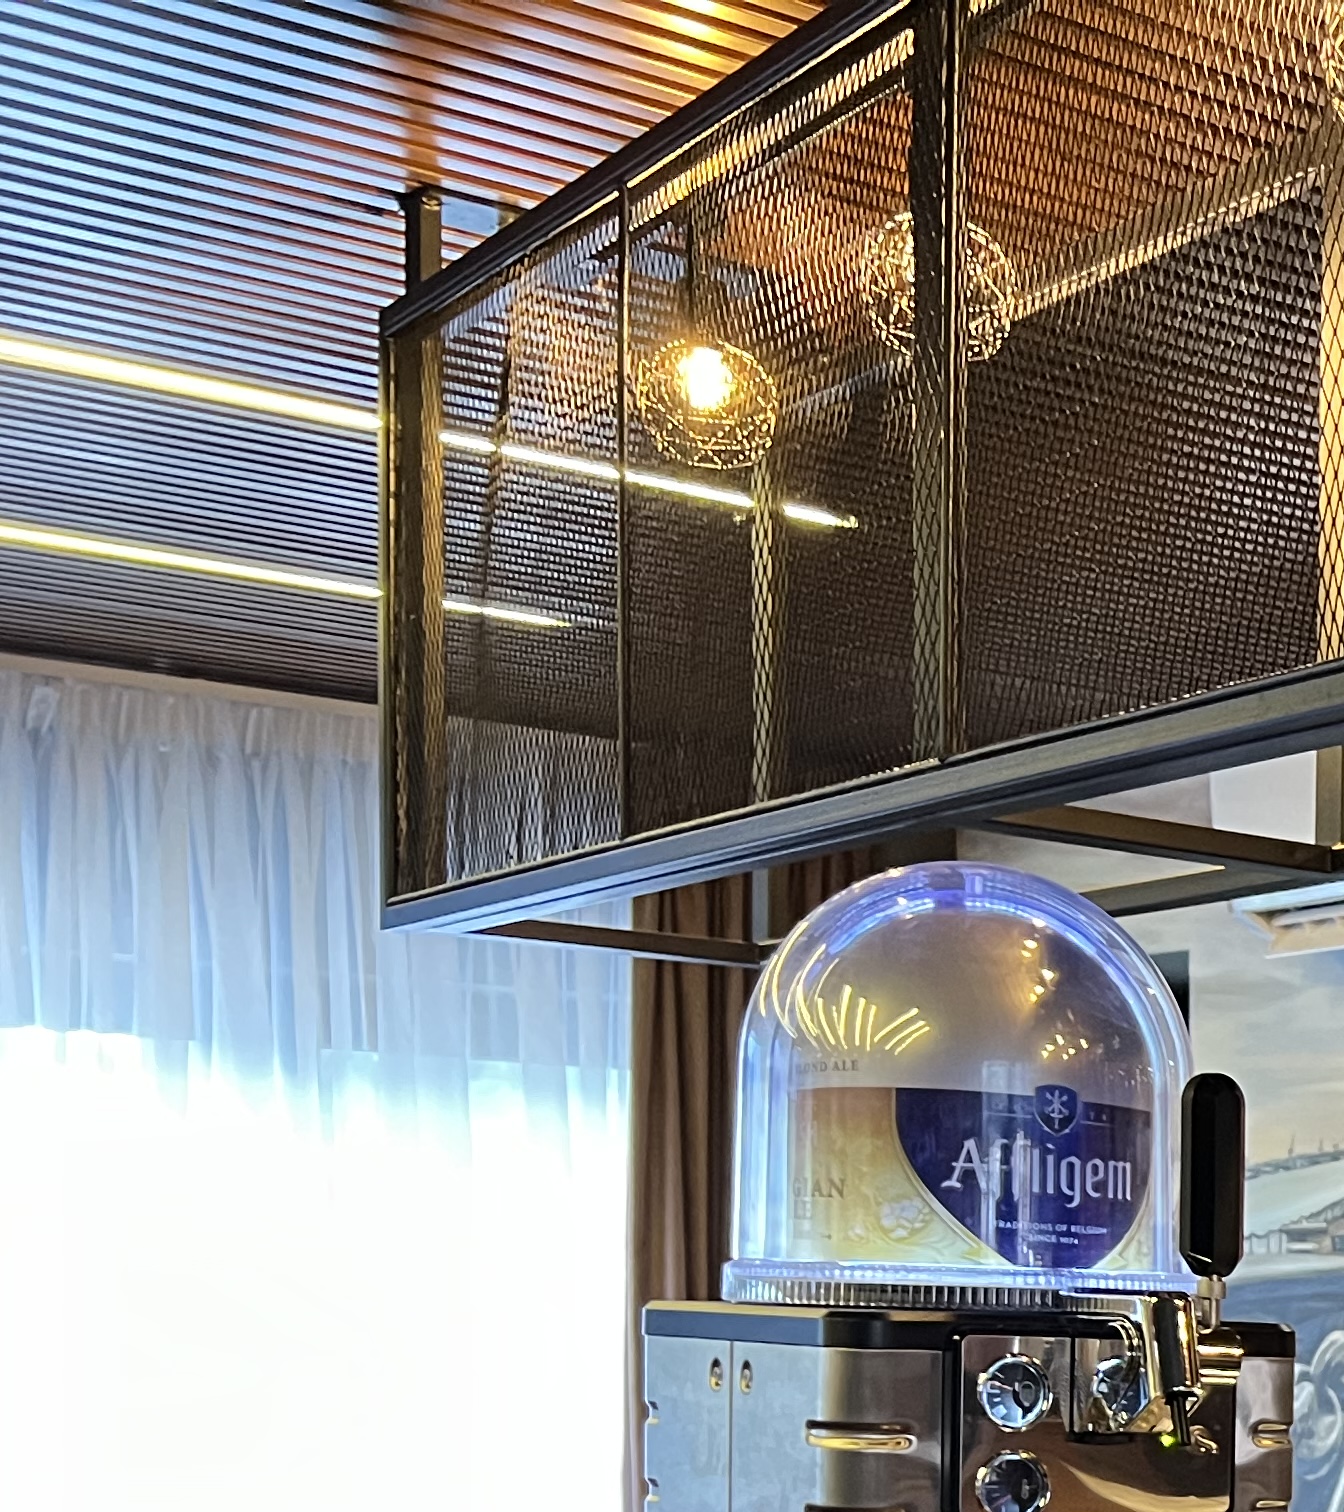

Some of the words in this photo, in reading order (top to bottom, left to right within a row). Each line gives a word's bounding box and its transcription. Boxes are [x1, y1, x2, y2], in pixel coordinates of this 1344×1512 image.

[794, 1061, 828, 1075] LOND
[831, 1058, 860, 1073] ALE
[940, 1131, 1132, 1208] Affligem
[792, 1176, 847, 1199] GIAN
